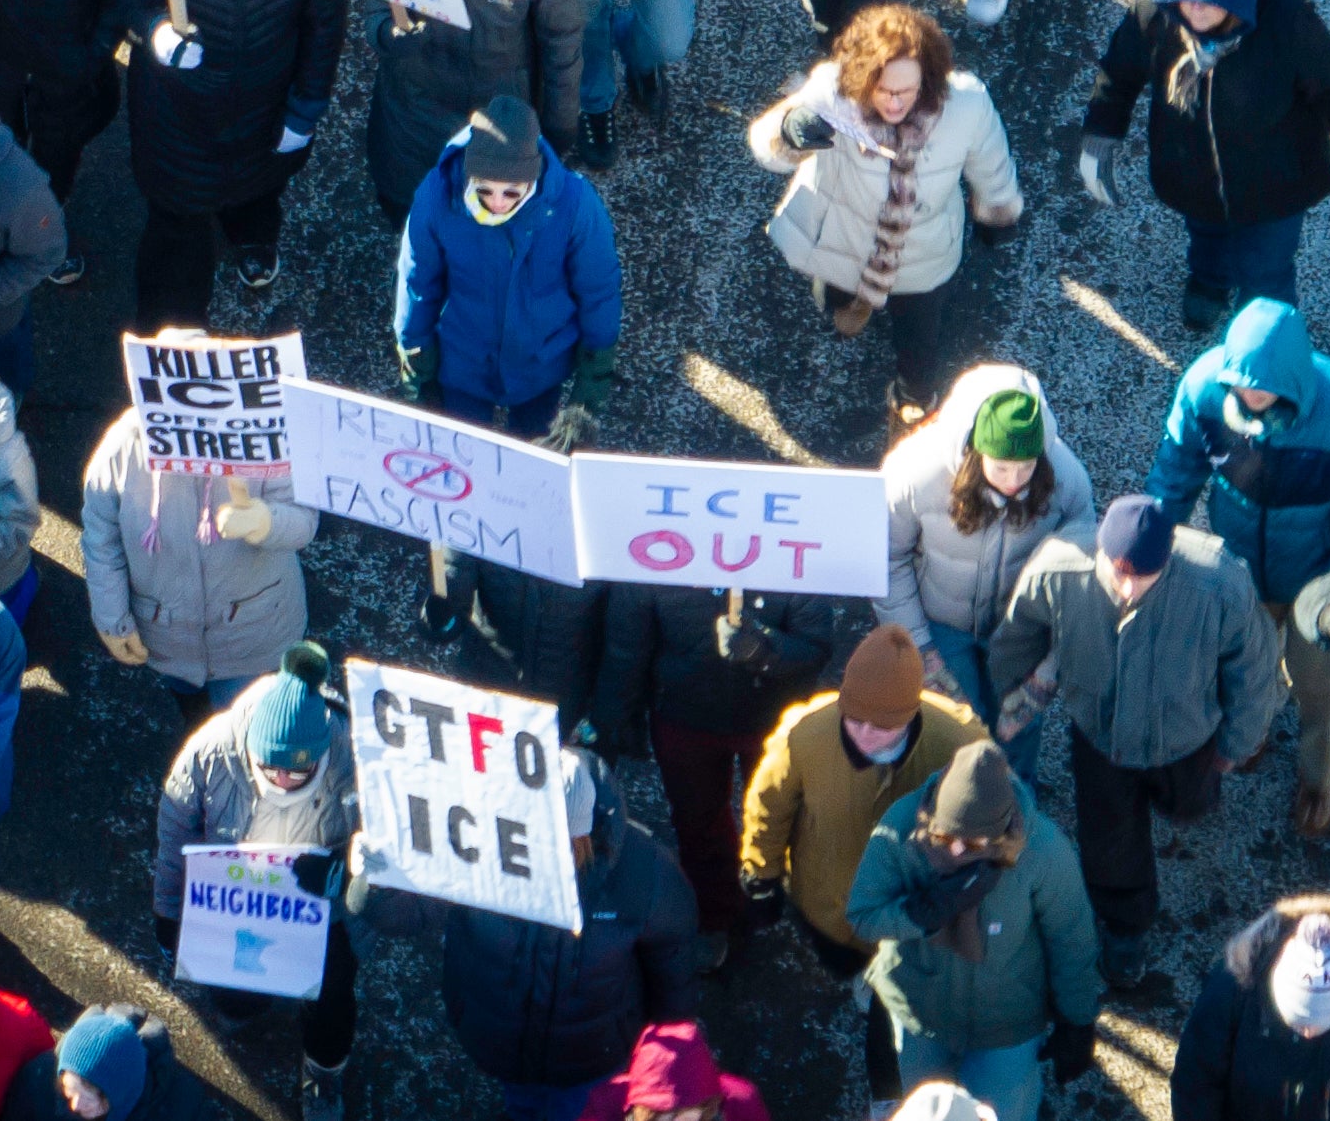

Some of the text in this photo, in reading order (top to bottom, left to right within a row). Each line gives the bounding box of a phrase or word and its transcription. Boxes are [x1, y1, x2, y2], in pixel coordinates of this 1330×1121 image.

[146, 345, 282, 380] KILLER
[138, 378, 283, 410] ICE
[146, 411, 218, 426] OFF
[336, 397, 505, 476] REJECT
[146, 426, 290, 461] STREET
[326, 474, 523, 568] FASCISM
[646, 484, 801, 524] ICE
[629, 529, 822, 578] OUT
[373, 688, 548, 790] GTFO
[407, 794, 531, 879] ICE
[190, 880, 324, 925] NEIGHBORS
